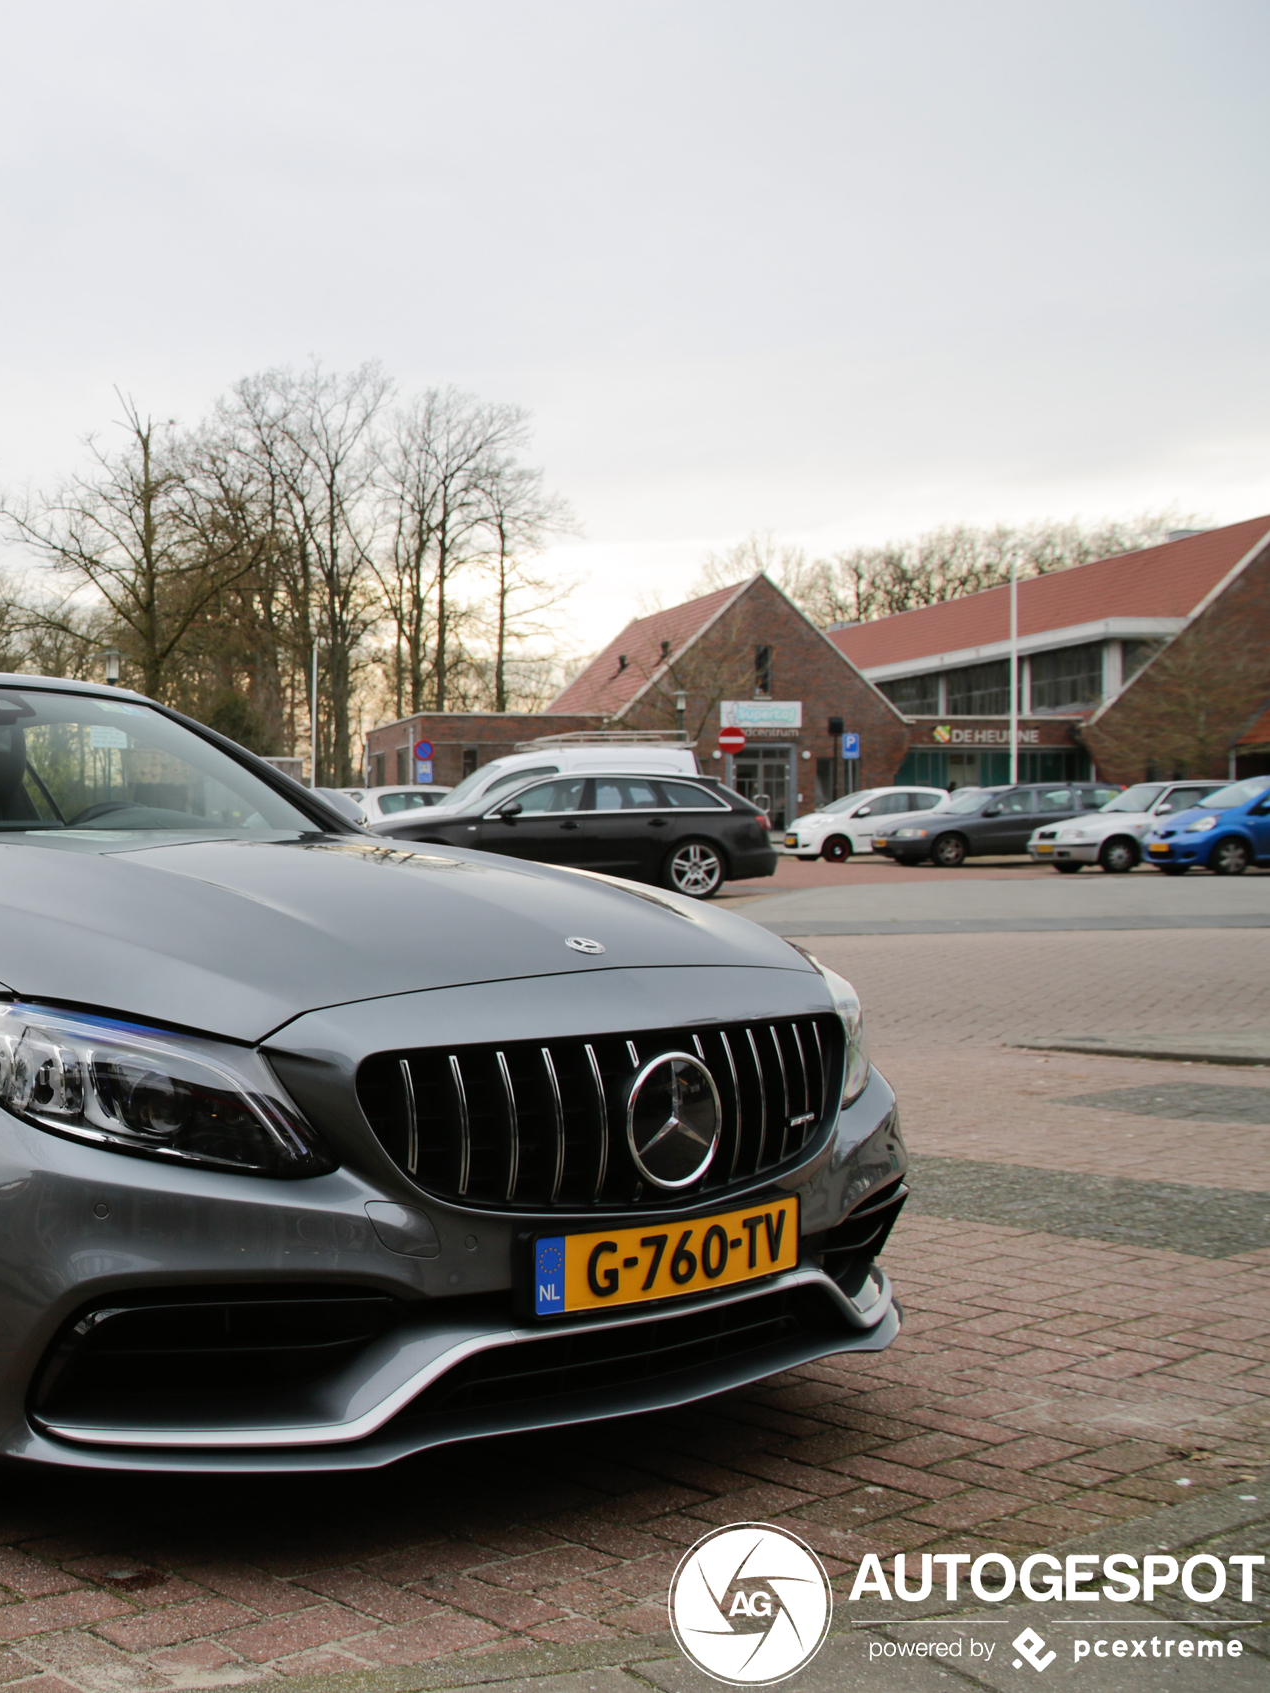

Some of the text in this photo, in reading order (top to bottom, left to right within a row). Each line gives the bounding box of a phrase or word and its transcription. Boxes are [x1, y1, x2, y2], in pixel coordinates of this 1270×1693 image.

[846, 735, 856, 748] P
[587, 1209, 786, 1297] G-760-TV
[539, 1284, 561, 1302] NL
